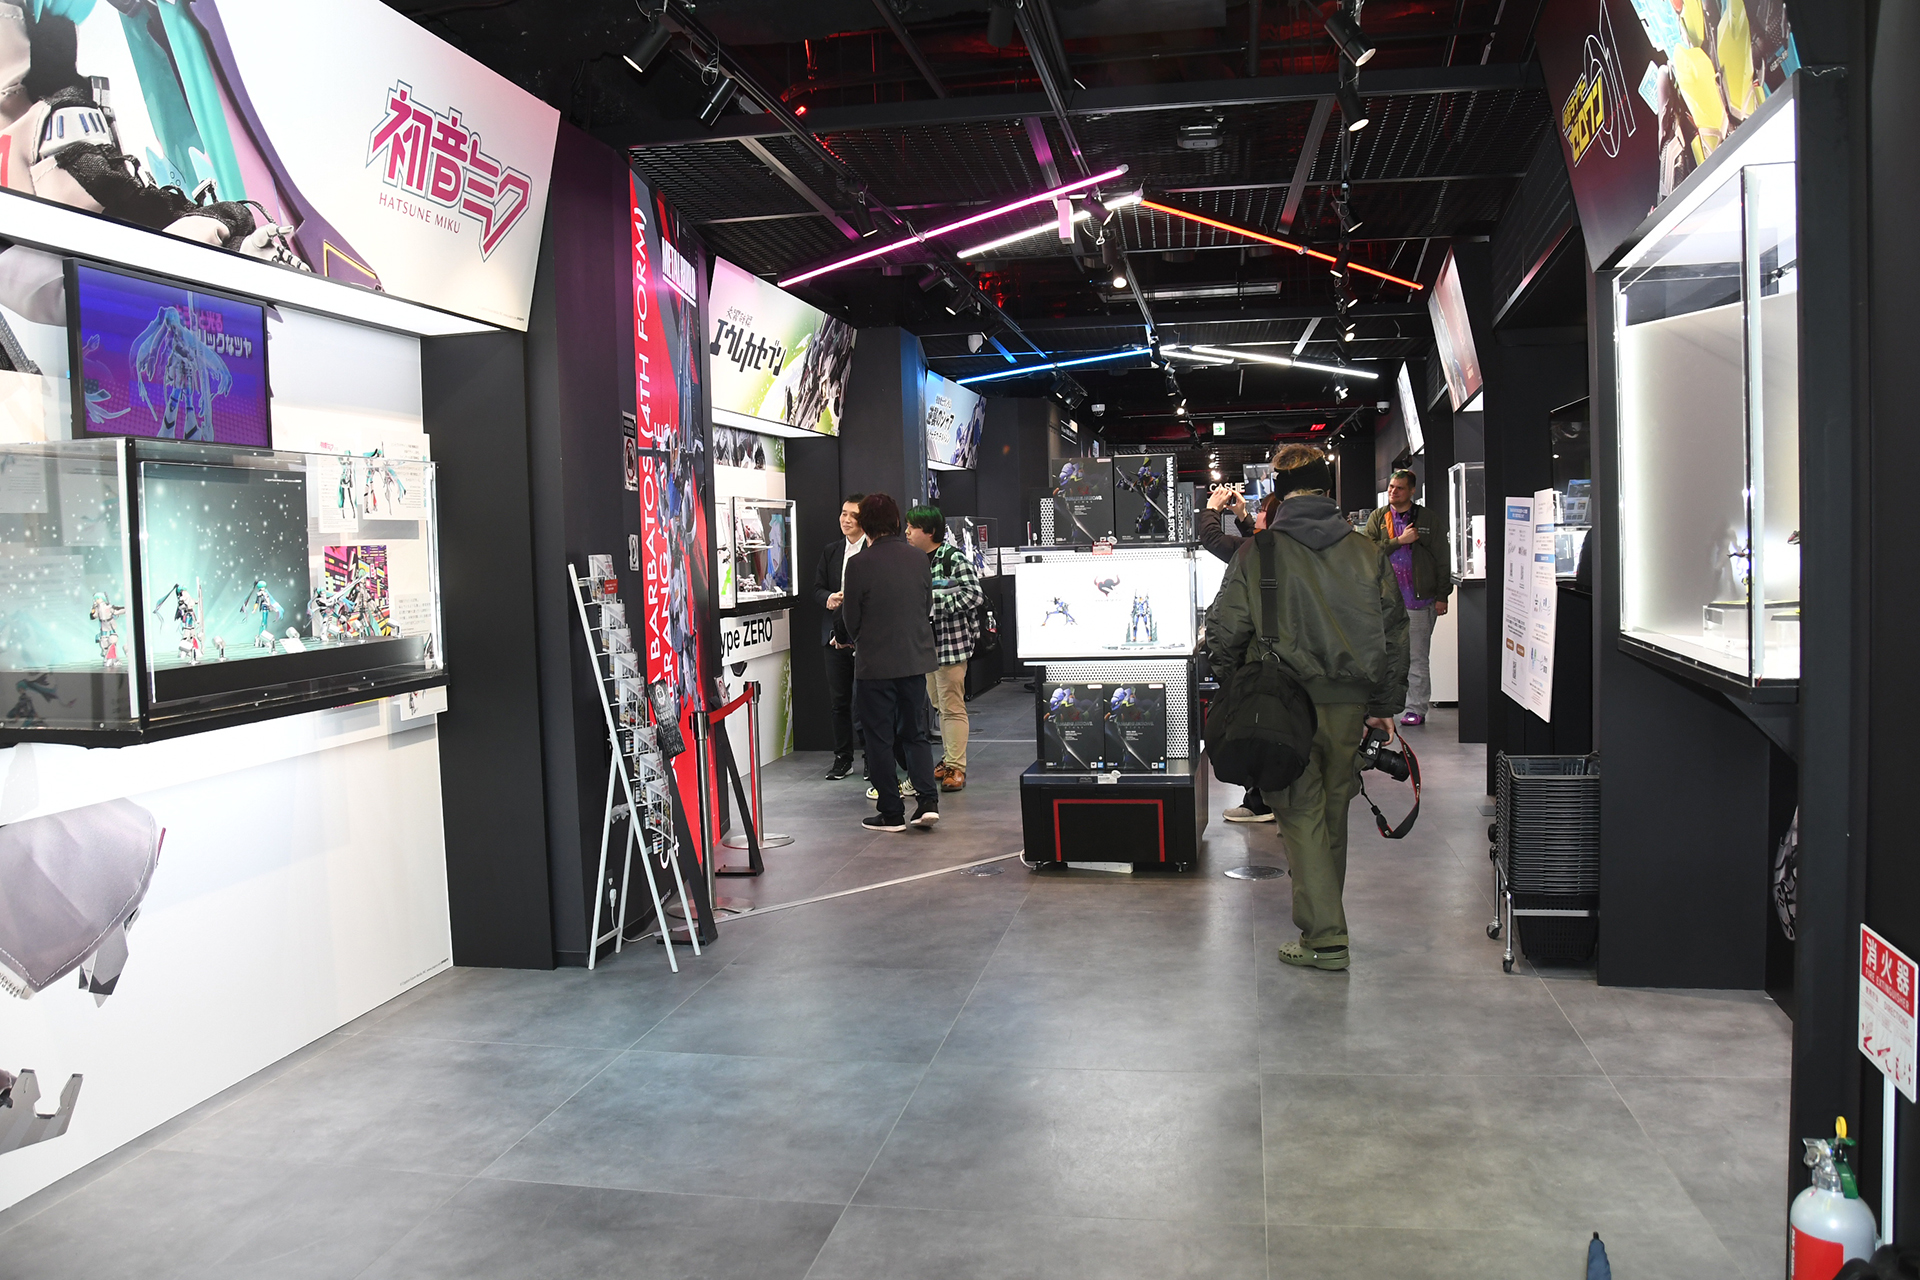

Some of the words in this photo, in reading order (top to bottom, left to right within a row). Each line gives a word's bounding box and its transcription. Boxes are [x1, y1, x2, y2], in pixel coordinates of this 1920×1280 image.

[1569, 76, 1604, 163] ゼロワン
[366, 79, 532, 262] 初音ミク
[379, 192, 431, 223] HATSUNE
[434, 214, 461, 234] MIKU
[633, 207, 648, 341] FORM)
[710, 318, 787, 376] エウレカセブン
[638, 353, 654, 439] (4TH
[1209, 482, 1246, 493] CASHIE
[643, 456, 660, 660] BARBATOS
[743, 617, 773, 647] ZERO
[1865, 936, 1910, 997] 消火器
[1865, 967, 1875, 983] FIRE
[1876, 975, 1910, 1012] EXTINGUISHER
